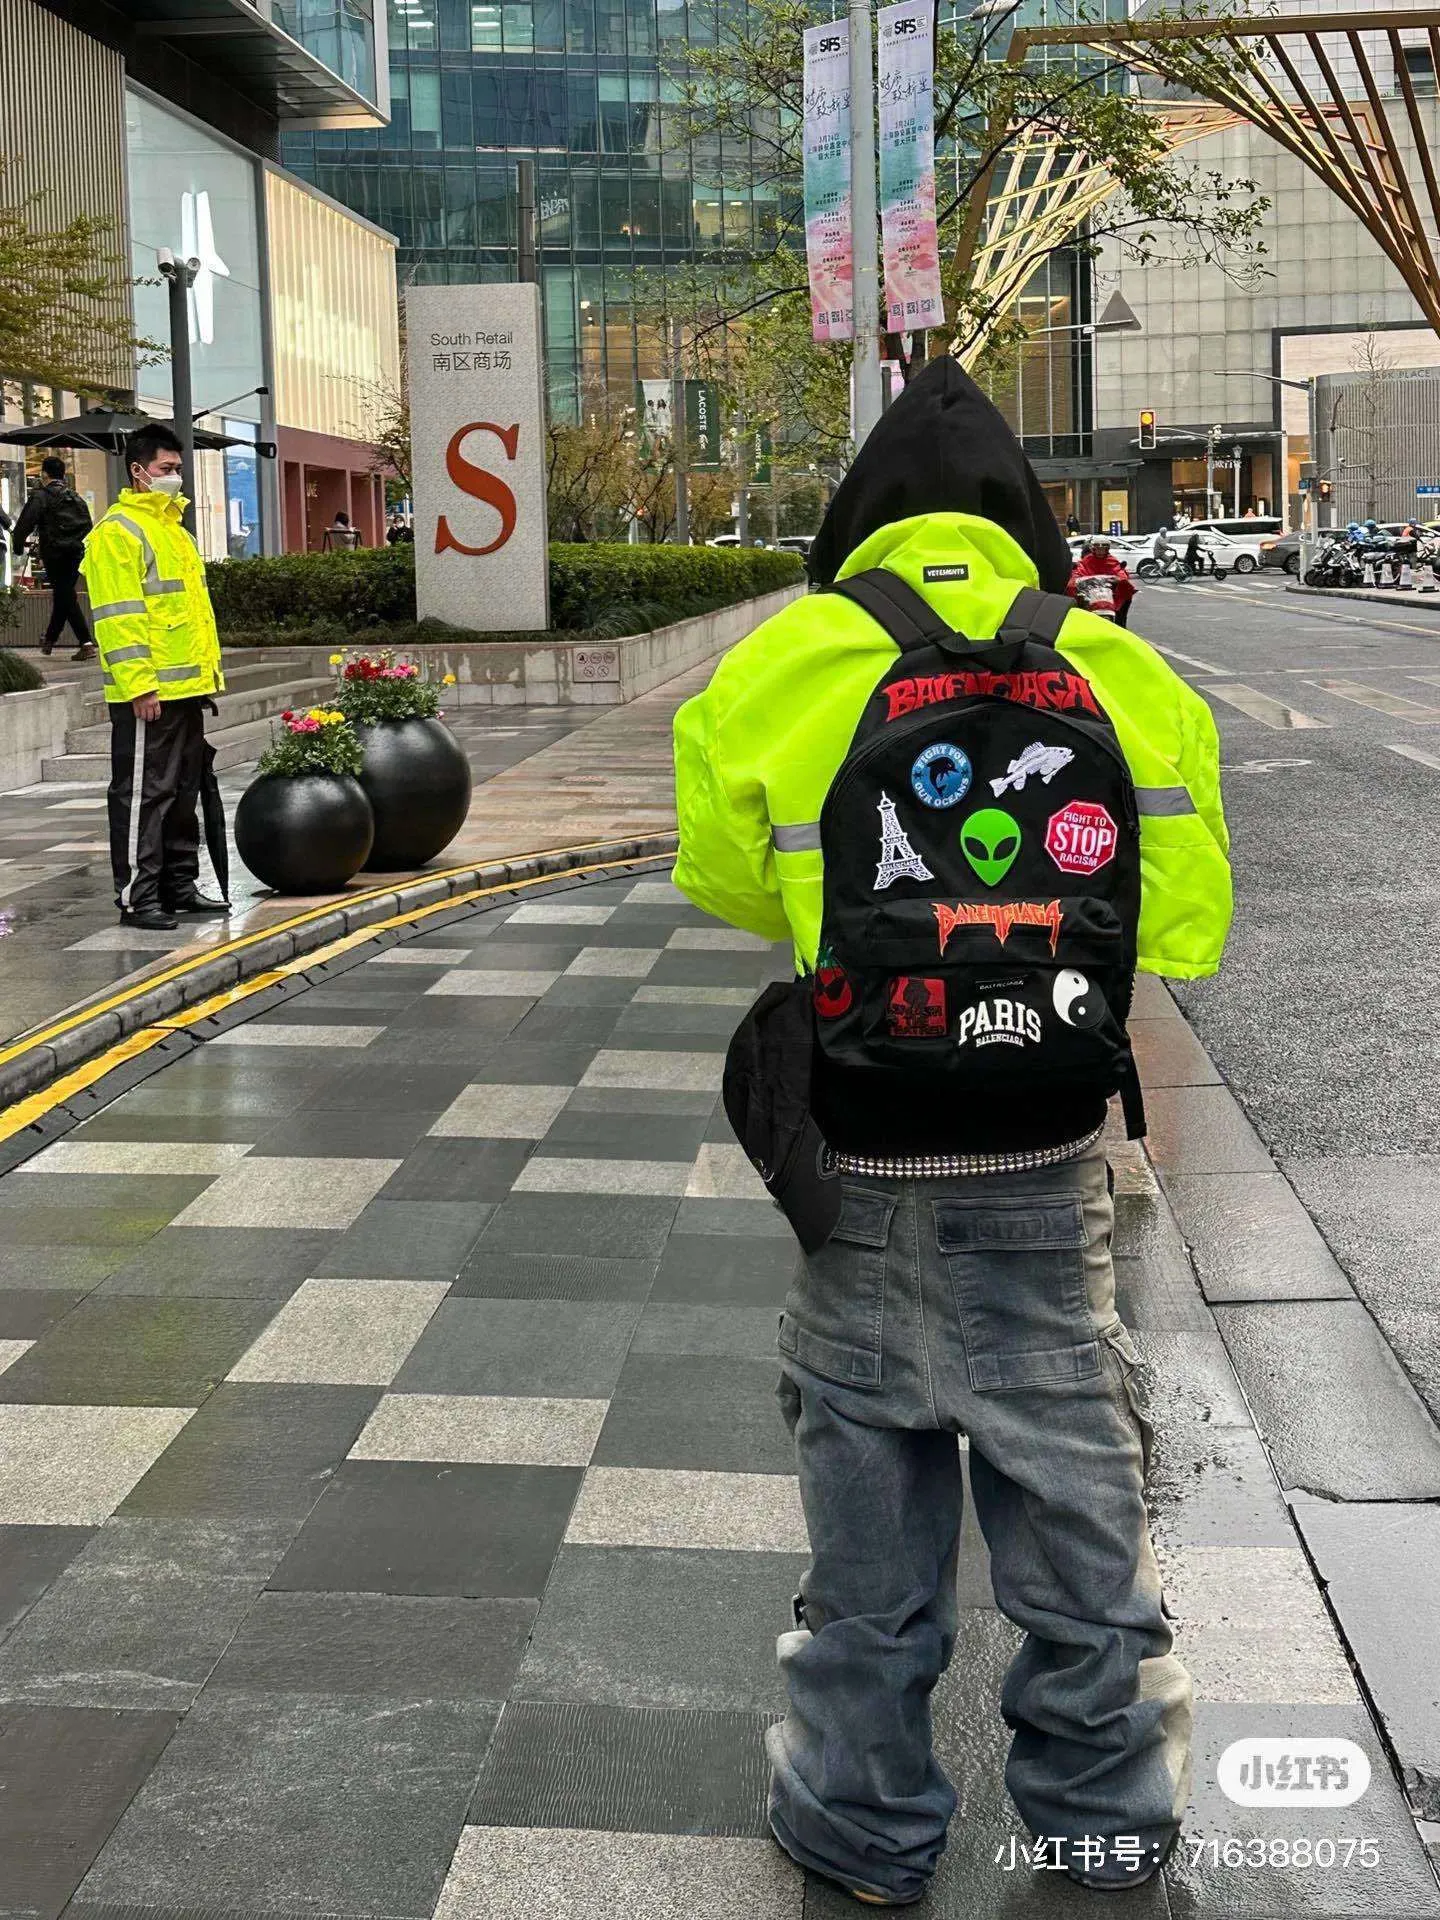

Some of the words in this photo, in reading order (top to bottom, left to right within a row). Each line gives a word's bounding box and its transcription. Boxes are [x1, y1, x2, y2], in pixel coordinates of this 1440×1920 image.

[895, 19, 916, 34] SIFS
[819, 37, 840, 52] SIFS
[430, 332, 471, 346] South
[475, 331, 513, 345] Retail
[432, 351, 512, 371] 南区商场
[1399, 369, 1431, 378] PLACE
[698, 390, 707, 430] LACOSTE
[434, 421, 520, 557] S
[927, 568, 965, 577] VETEMENTS
[882, 671, 1104, 723] BALENCIAGA
[915, 746, 947, 769] FIGHT
[949, 747, 966, 767] FOR
[915, 782, 932, 804] OUR
[934, 777, 969, 806] OCEANS
[1063, 811, 1092, 825] FIGHT
[1093, 816, 1107, 827] TO
[1053, 821, 1111, 857] STOP
[1059, 852, 1098, 867] RACISM
[931, 899, 1063, 958] BALENCIAGA
[959, 998, 1041, 1047] PARIS
[976, 1033, 1025, 1047] BALENCIAGA
